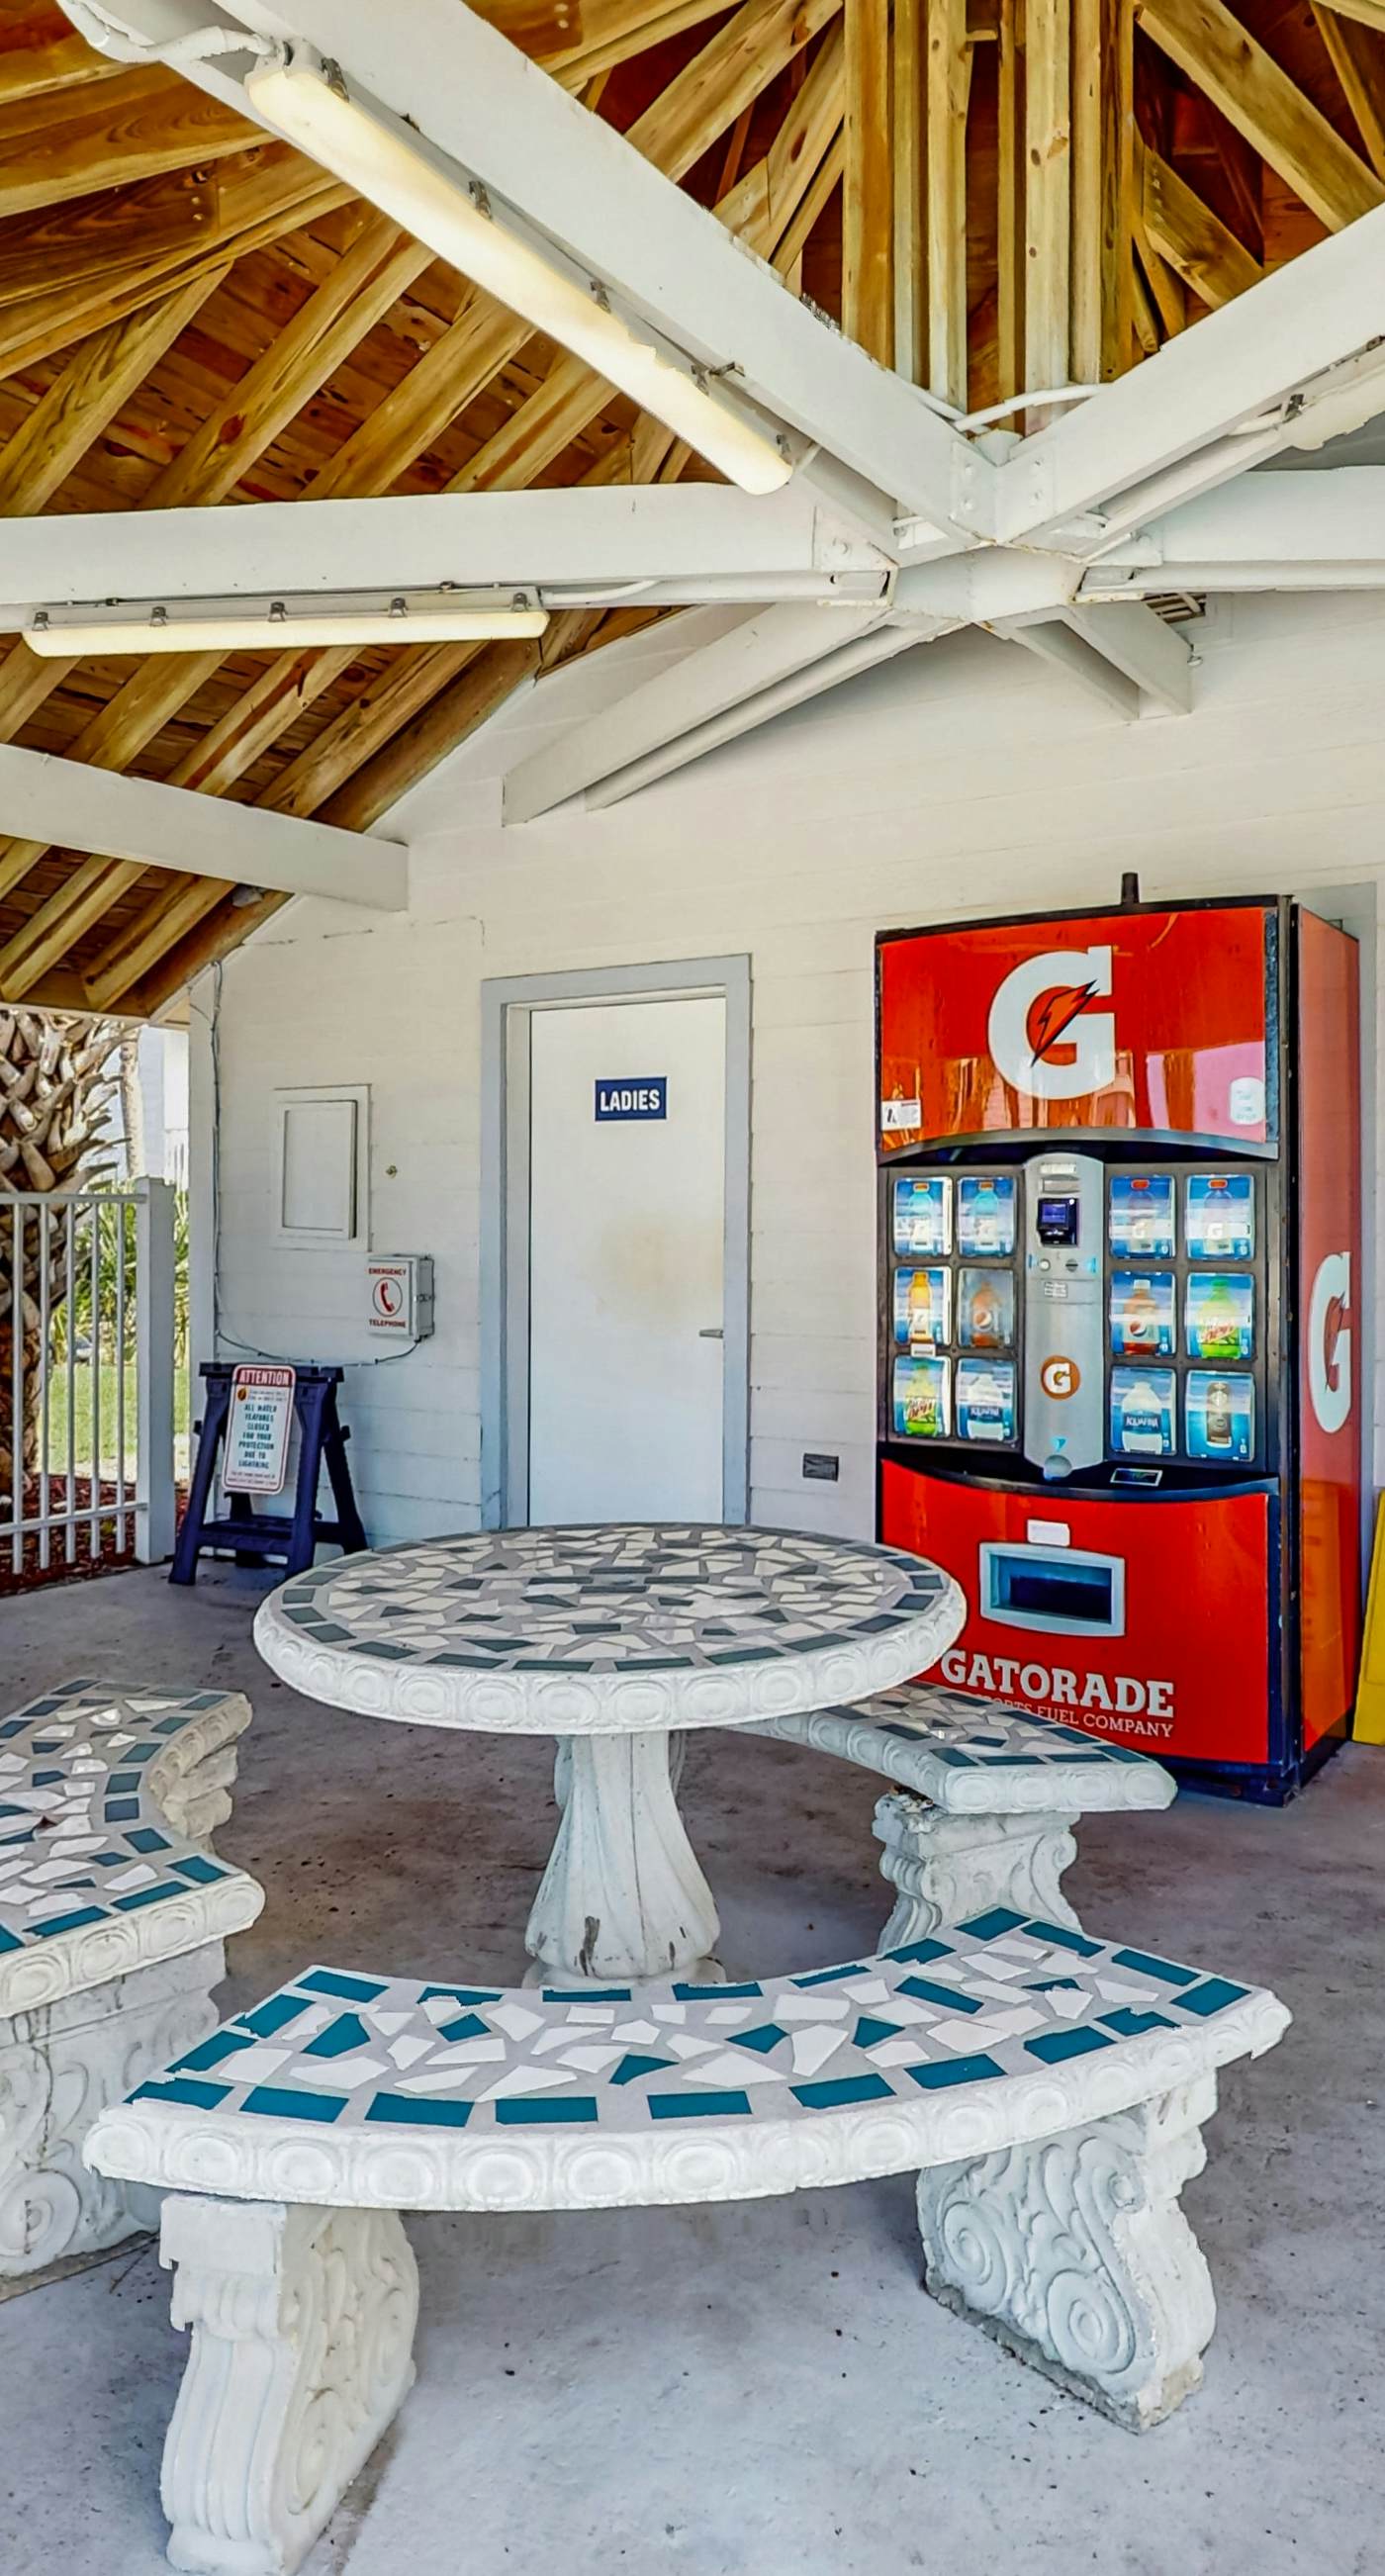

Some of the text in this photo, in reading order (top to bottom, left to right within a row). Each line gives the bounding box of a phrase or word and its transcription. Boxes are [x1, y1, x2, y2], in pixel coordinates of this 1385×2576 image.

[987, 945, 1116, 1100] G
[600, 1088, 661, 1112] LADIES
[368, 1267, 407, 1276] EMERGENCY
[369, 1319, 407, 1329] TELEPHONE
[1307, 1250, 1352, 1433] G
[238, 1369, 290, 1386] ATTENTION
[1046, 1362, 1071, 1394] G
[238, 1440, 275, 1450] PROTECTION
[256, 1432, 272, 1441] YOUR
[237, 1459, 270, 1469] LIGHTNING
[941, 1648, 1175, 1718] GATORADE
[1036, 1704, 1080, 1725] FUEL
[1082, 1712, 1174, 1738] COMPANY
